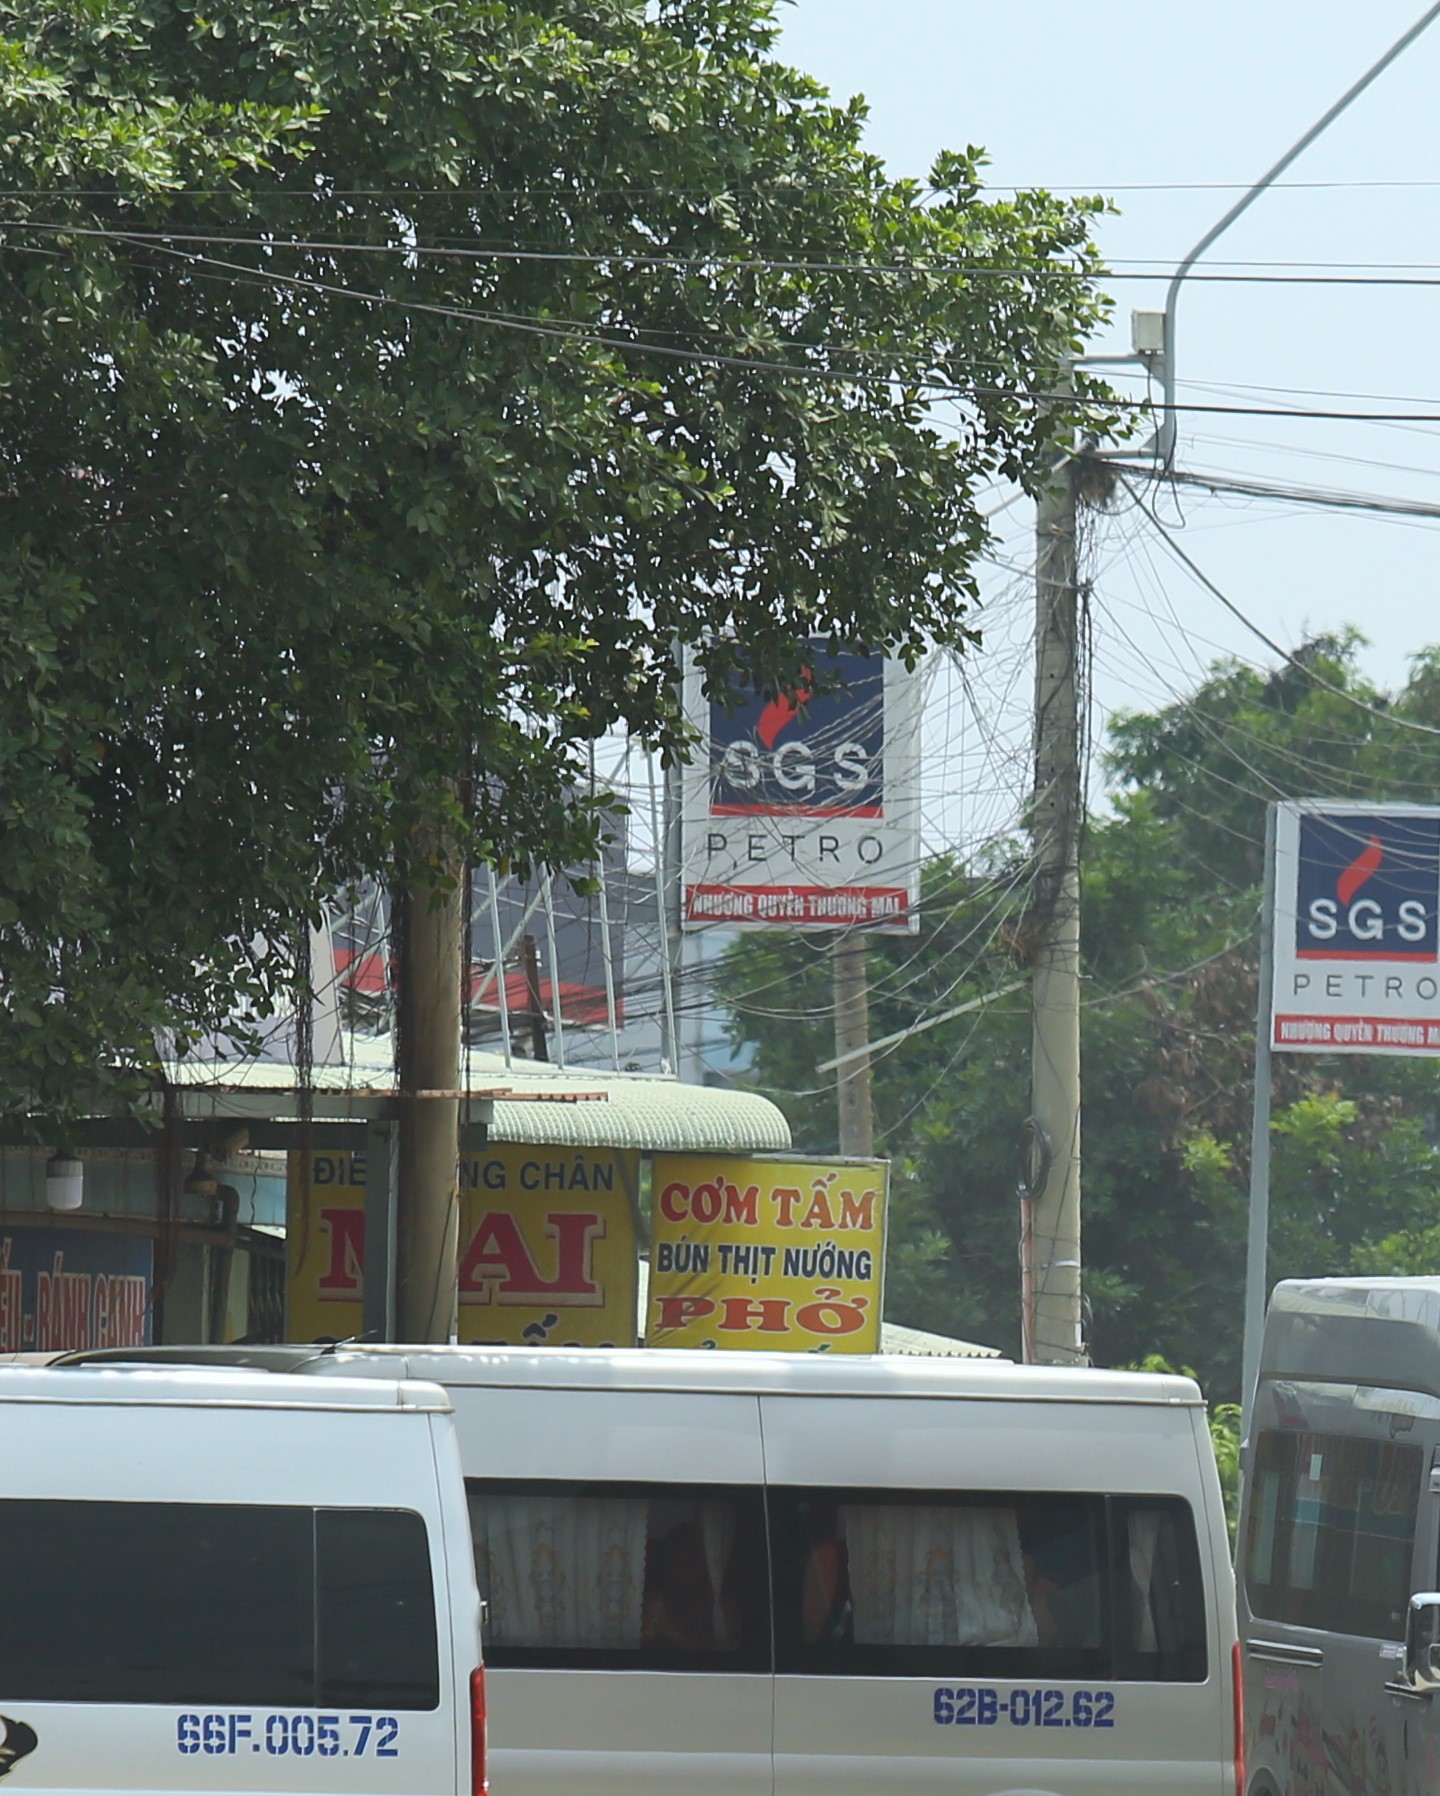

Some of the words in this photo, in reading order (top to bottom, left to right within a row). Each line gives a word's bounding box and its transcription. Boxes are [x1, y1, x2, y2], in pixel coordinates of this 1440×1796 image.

[723, 739, 869, 791] SGS
[707, 833, 883, 865] PETRO
[1308, 898, 1427, 942] SGS
[1293, 974, 1438, 1000] PETRO
[519, 1154, 614, 1191] CHÂN
[660, 1175, 760, 1226] CƠM
[771, 1171, 877, 1231] TẤM
[656, 1235, 710, 1274] BÚN
[717, 1244, 777, 1285] THỊT
[782, 1240, 873, 1281] NƯỚNG
[653, 1287, 870, 1336] PHỞ
[932, 1687, 1116, 1729] 62B-012.62
[176, 1713, 399, 1758] 66F.005.72
